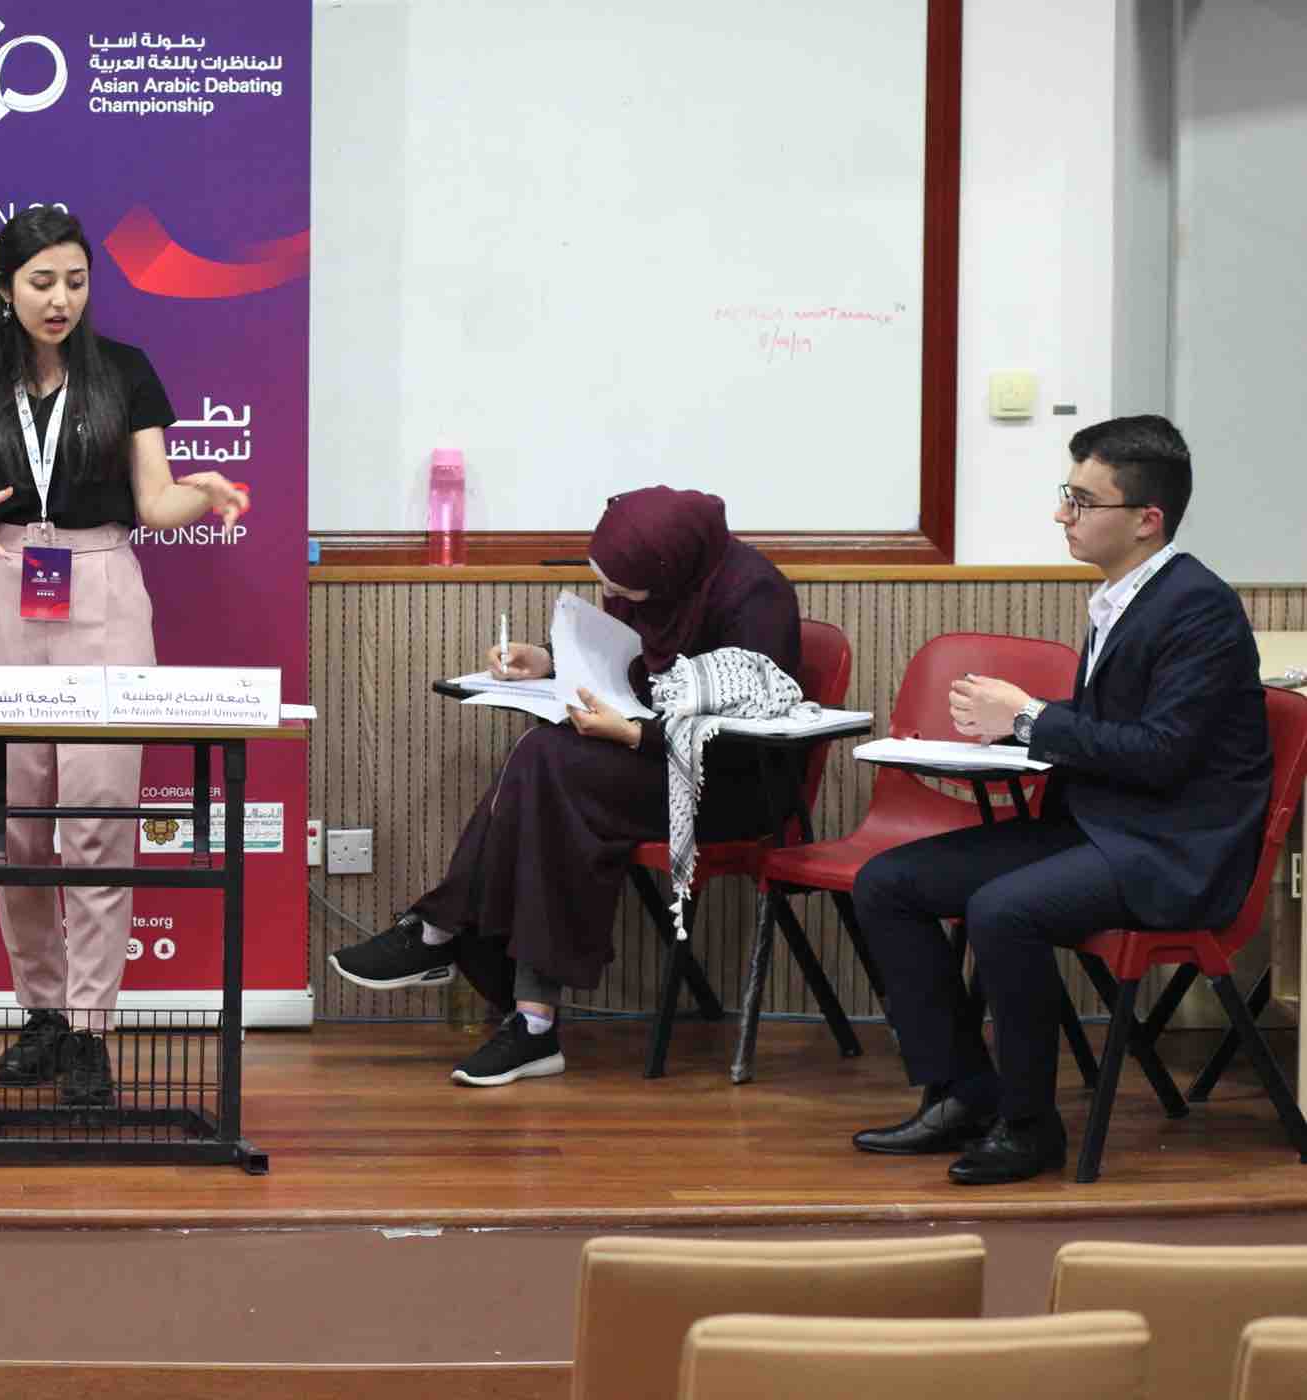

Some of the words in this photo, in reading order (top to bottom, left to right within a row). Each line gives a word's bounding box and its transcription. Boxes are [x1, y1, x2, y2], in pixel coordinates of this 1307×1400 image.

[140, 31, 206, 51] بطولة
[88, 54, 145, 73] العربية
[147, 54, 198, 73] باللغة
[201, 55, 283, 72] للمناظرات
[89, 77, 139, 93] Asian
[143, 77, 201, 93] Arabic
[204, 77, 283, 96] Debating
[88, 97, 214, 116] Championship
[169, 396, 251, 437] بط
[166, 439, 251, 462] للمناظ
[25, 689, 77, 704] جامعة
[216, 692, 261, 704] جامعة
[29, 707, 101, 720] University
